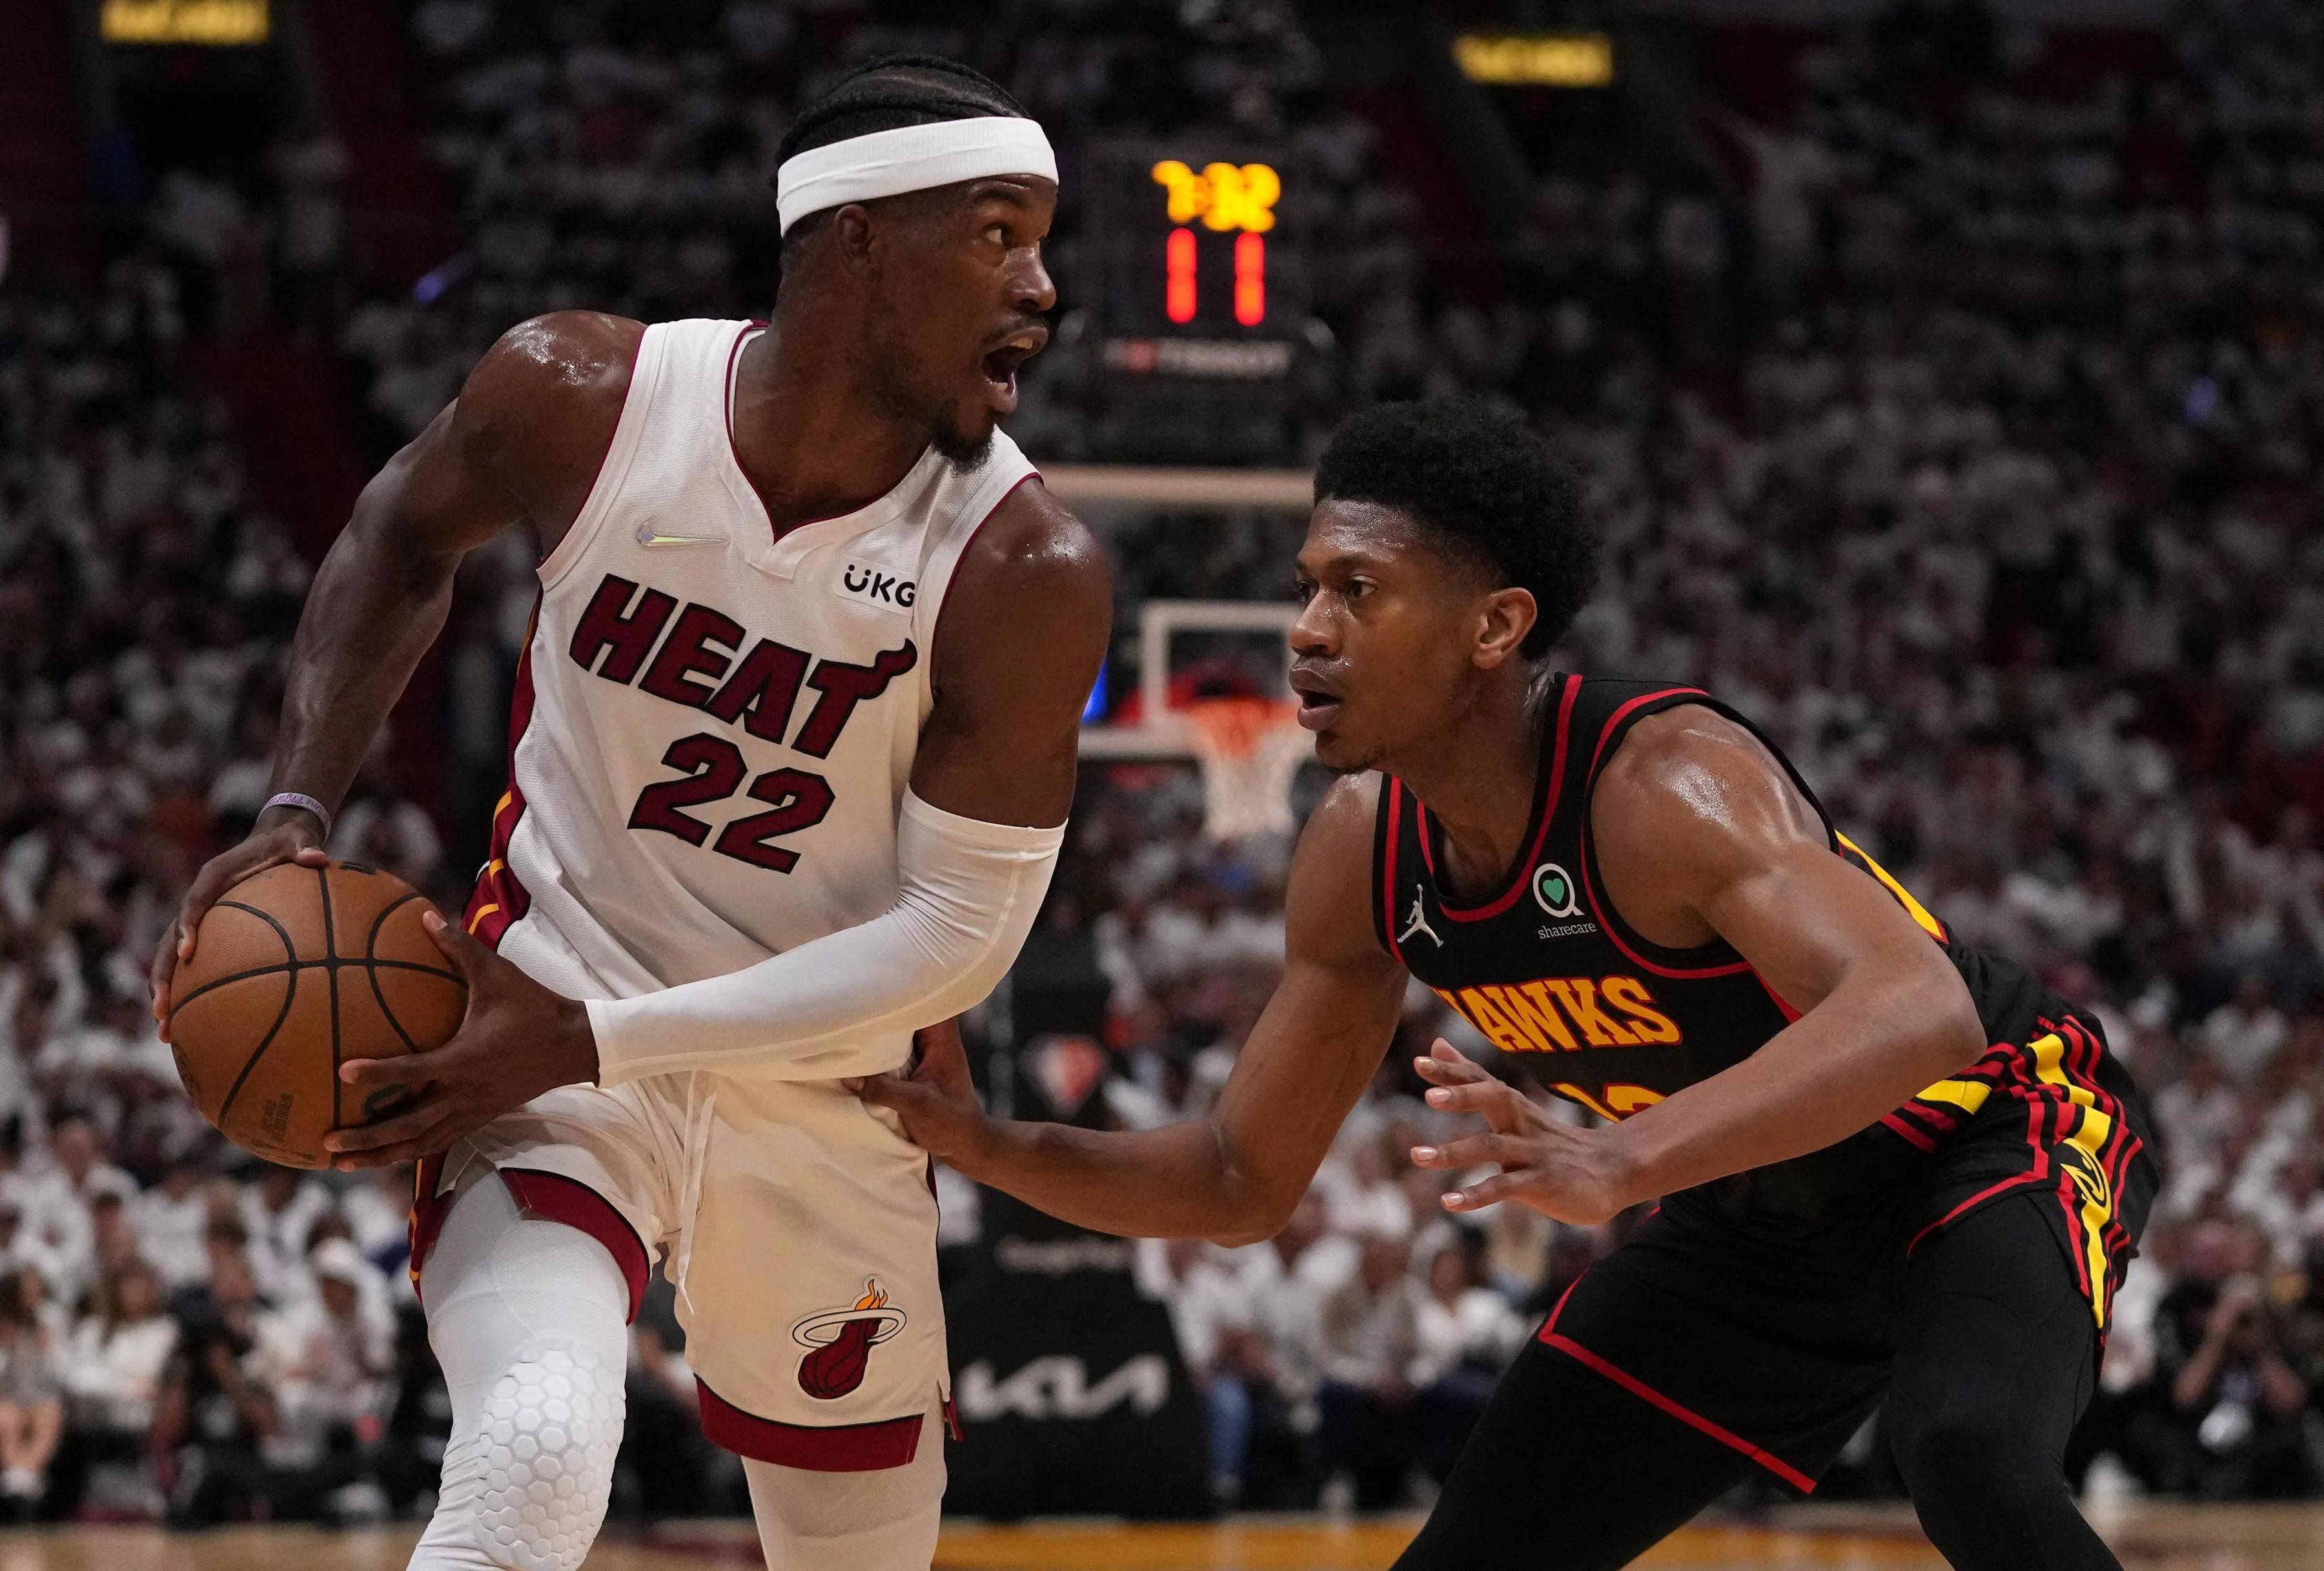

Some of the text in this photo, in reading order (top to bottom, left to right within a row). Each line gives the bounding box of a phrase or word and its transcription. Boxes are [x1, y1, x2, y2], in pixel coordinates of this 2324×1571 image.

[1167, 227, 1265, 327] 11
[569, 573, 918, 760] HEAT
[627, 731, 836, 875] 22
[1538, 922, 1596, 940] sharecare
[1432, 975, 1683, 1053] AWKS
